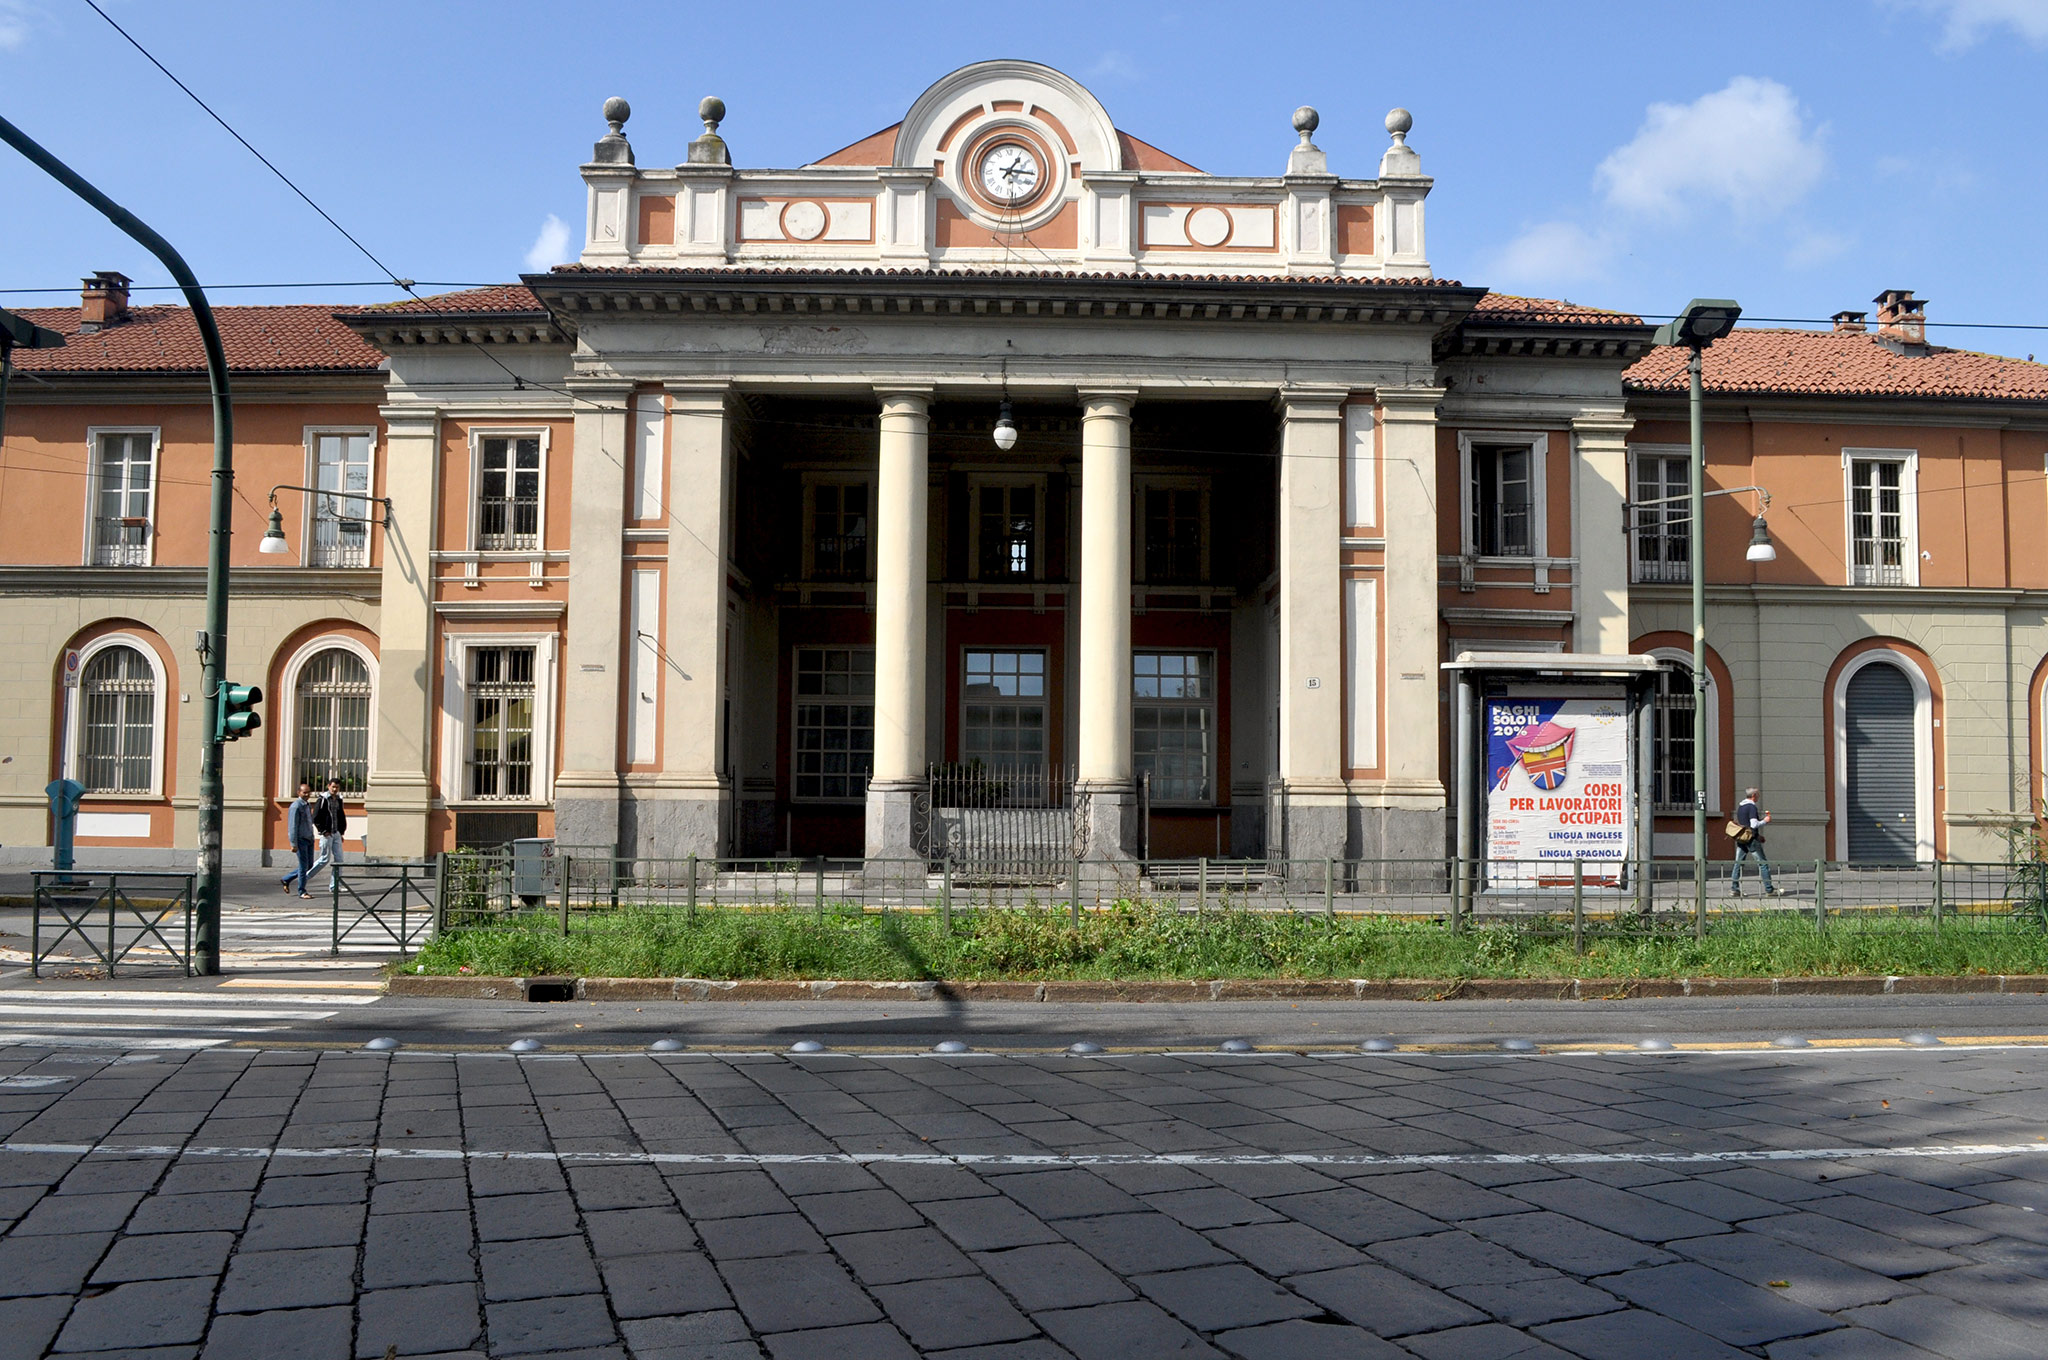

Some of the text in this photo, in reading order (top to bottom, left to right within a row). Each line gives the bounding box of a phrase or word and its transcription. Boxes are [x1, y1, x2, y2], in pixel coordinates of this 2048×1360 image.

[1309, 679, 1317, 687] 15
[1492, 705, 1540, 716] PAGHI
[1493, 715, 1540, 726] SOLO IL
[1493, 725, 1528, 737] 20%
[1584, 783, 1622, 797] CORSI
[1509, 797, 1622, 811] PER LAVORATORI
[1559, 811, 1622, 825] OCCUPATI
[1548, 831, 1623, 840] LINGUA INGLESE
[1539, 849, 1622, 858] LINGUA SPAGNOLA
